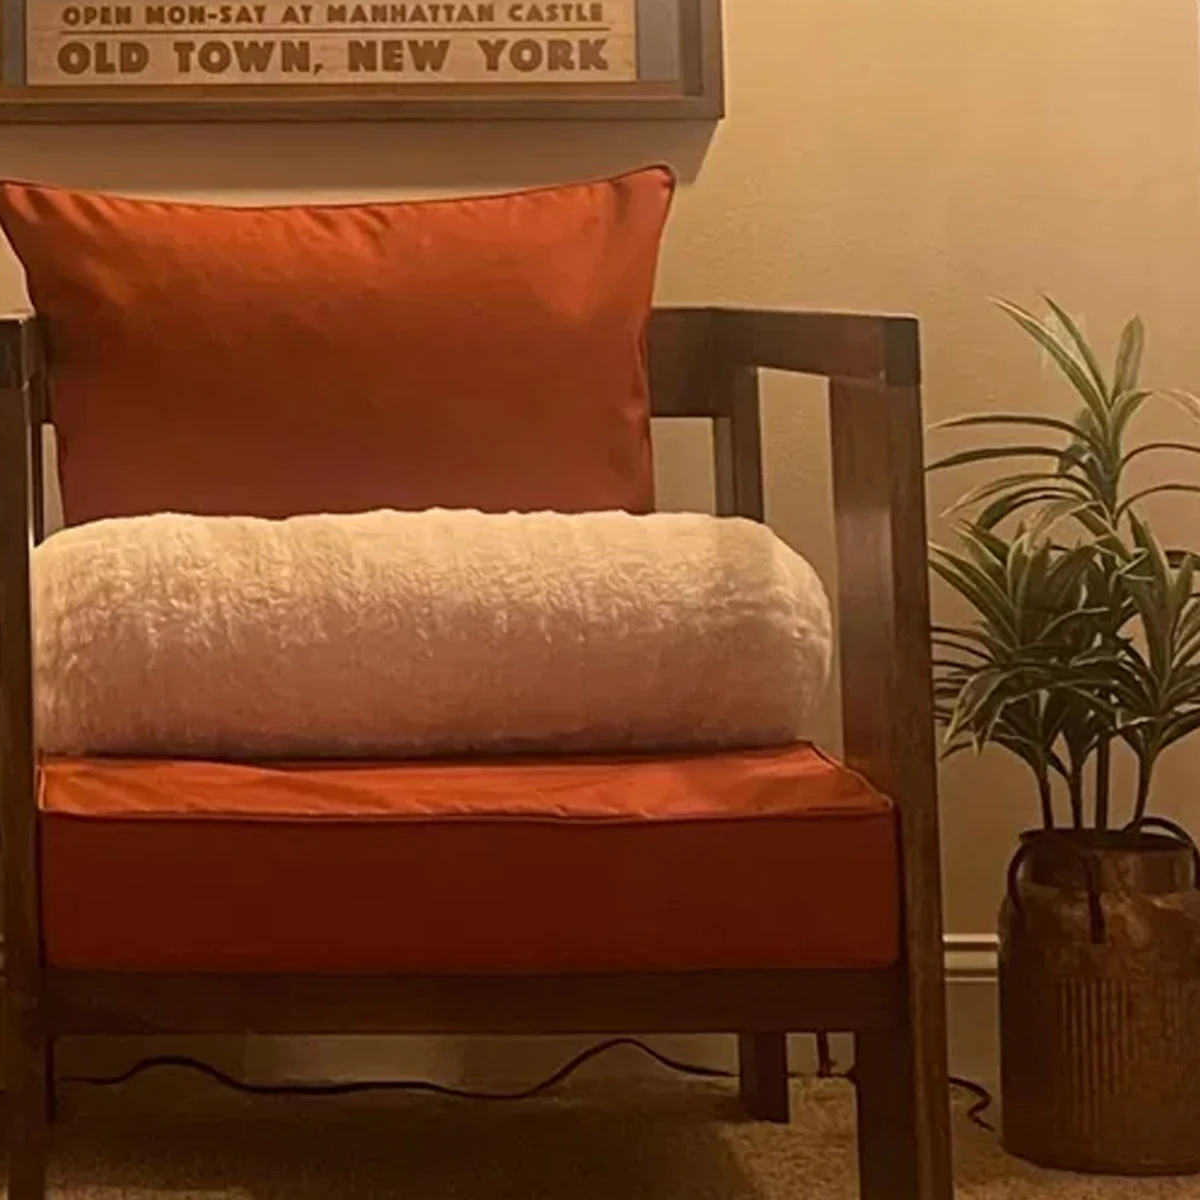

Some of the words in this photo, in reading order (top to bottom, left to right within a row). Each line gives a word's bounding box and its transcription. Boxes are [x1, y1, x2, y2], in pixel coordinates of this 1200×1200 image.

[62, 6, 131, 26] OPEN
[145, 5, 267, 25] MON-SAT
[281, 5, 312, 24] AT
[327, 3, 495, 23] MANHATTAN
[507, 3, 603, 22] CASTLE
[57, 40, 149, 75] OLD
[174, 40, 323, 76] TOWN,
[347, 39, 450, 73] NEW
[479, 39, 608, 72] YORK
